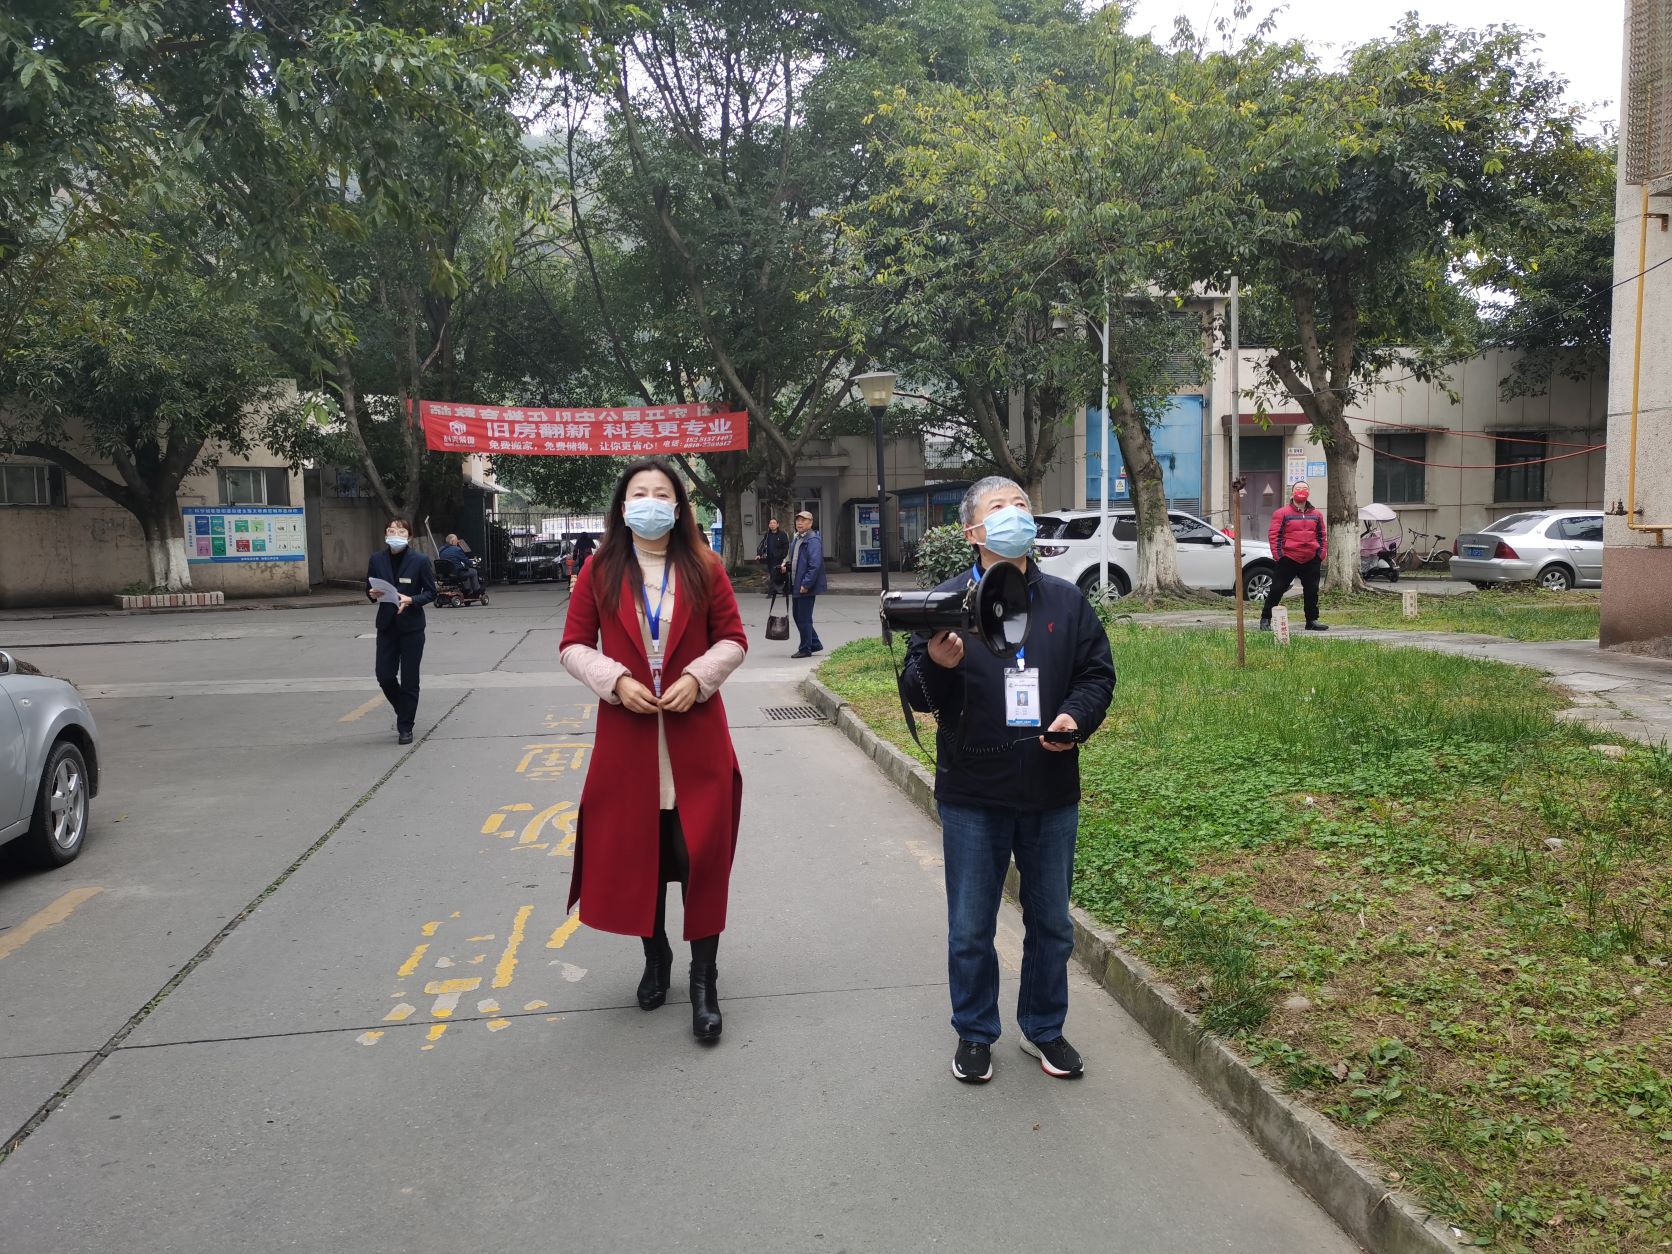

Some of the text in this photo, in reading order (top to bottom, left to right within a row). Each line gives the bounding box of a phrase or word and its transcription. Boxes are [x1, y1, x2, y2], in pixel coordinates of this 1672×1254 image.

[487, 418, 733, 439] 旧房翻新 科美更专业
